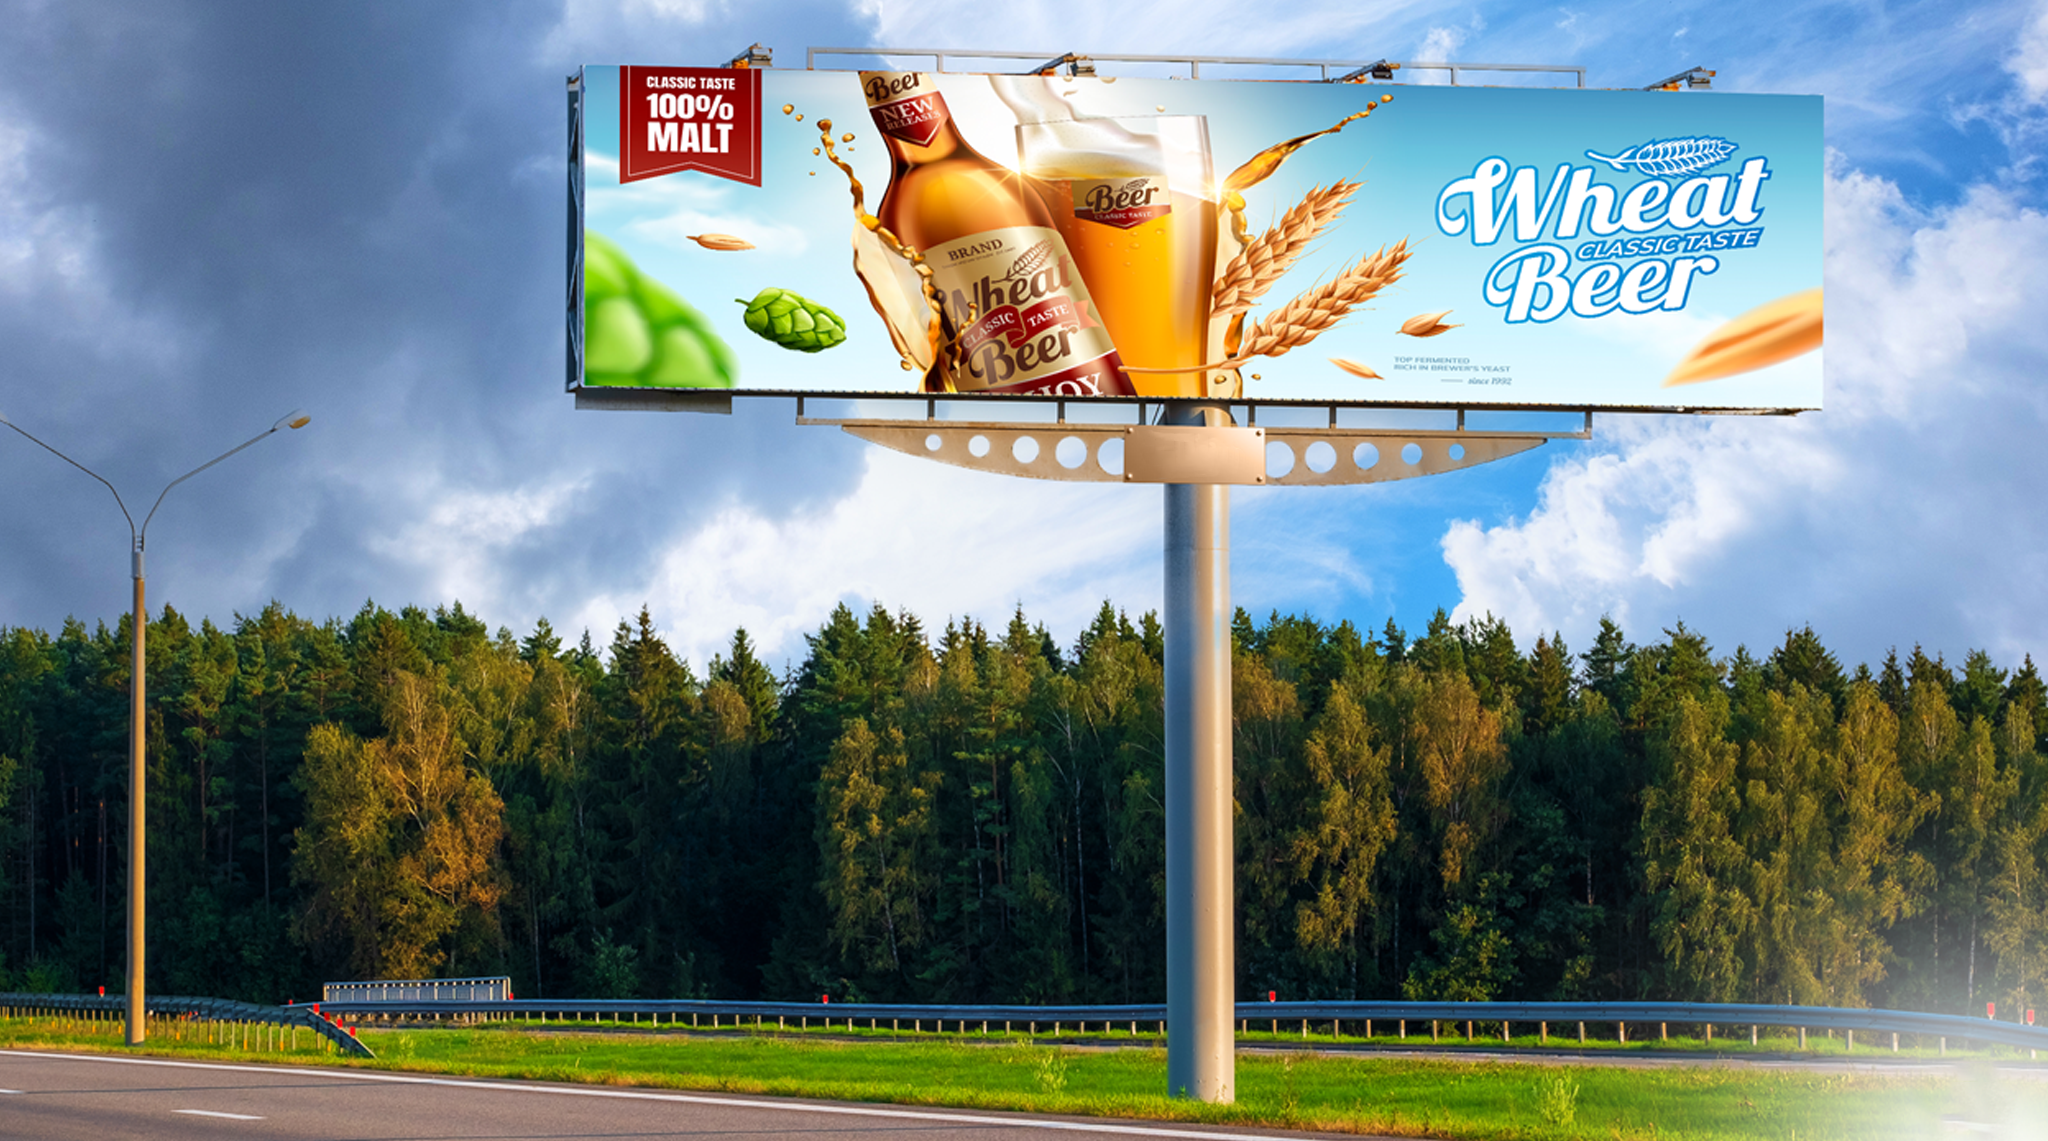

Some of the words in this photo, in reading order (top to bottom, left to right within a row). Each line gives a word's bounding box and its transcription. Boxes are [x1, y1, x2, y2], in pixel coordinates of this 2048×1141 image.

[646, 75, 697, 89] CLASSIC
[699, 77, 736, 91] TASTE
[865, 72, 923, 102] Beer
[646, 92, 735, 121] 100%
[879, 95, 934, 123] NEW
[884, 109, 942, 131] RELEASES
[647, 121, 734, 154] MALT
[1085, 184, 1160, 213] Beer
[1436, 155, 1771, 246] Wheat
[1094, 212, 1127, 221] CLASSIC
[1129, 211, 1153, 219] TASTE
[947, 238, 1003, 261] BRAND
[1577, 235, 1681, 260] CLASSIC
[1686, 228, 1762, 251] TASTE
[920, 253, 1073, 342] Wheat
[1483, 243, 1720, 324] Beer
[963, 312, 1016, 349] CLASSIC
[1027, 303, 1070, 328] TASTE
[968, 325, 1079, 386] Beer
[1414, 356, 1470, 365] FERMENTED
[1481, 365, 1511, 373] YEAST
[1468, 377, 1490, 386] since
